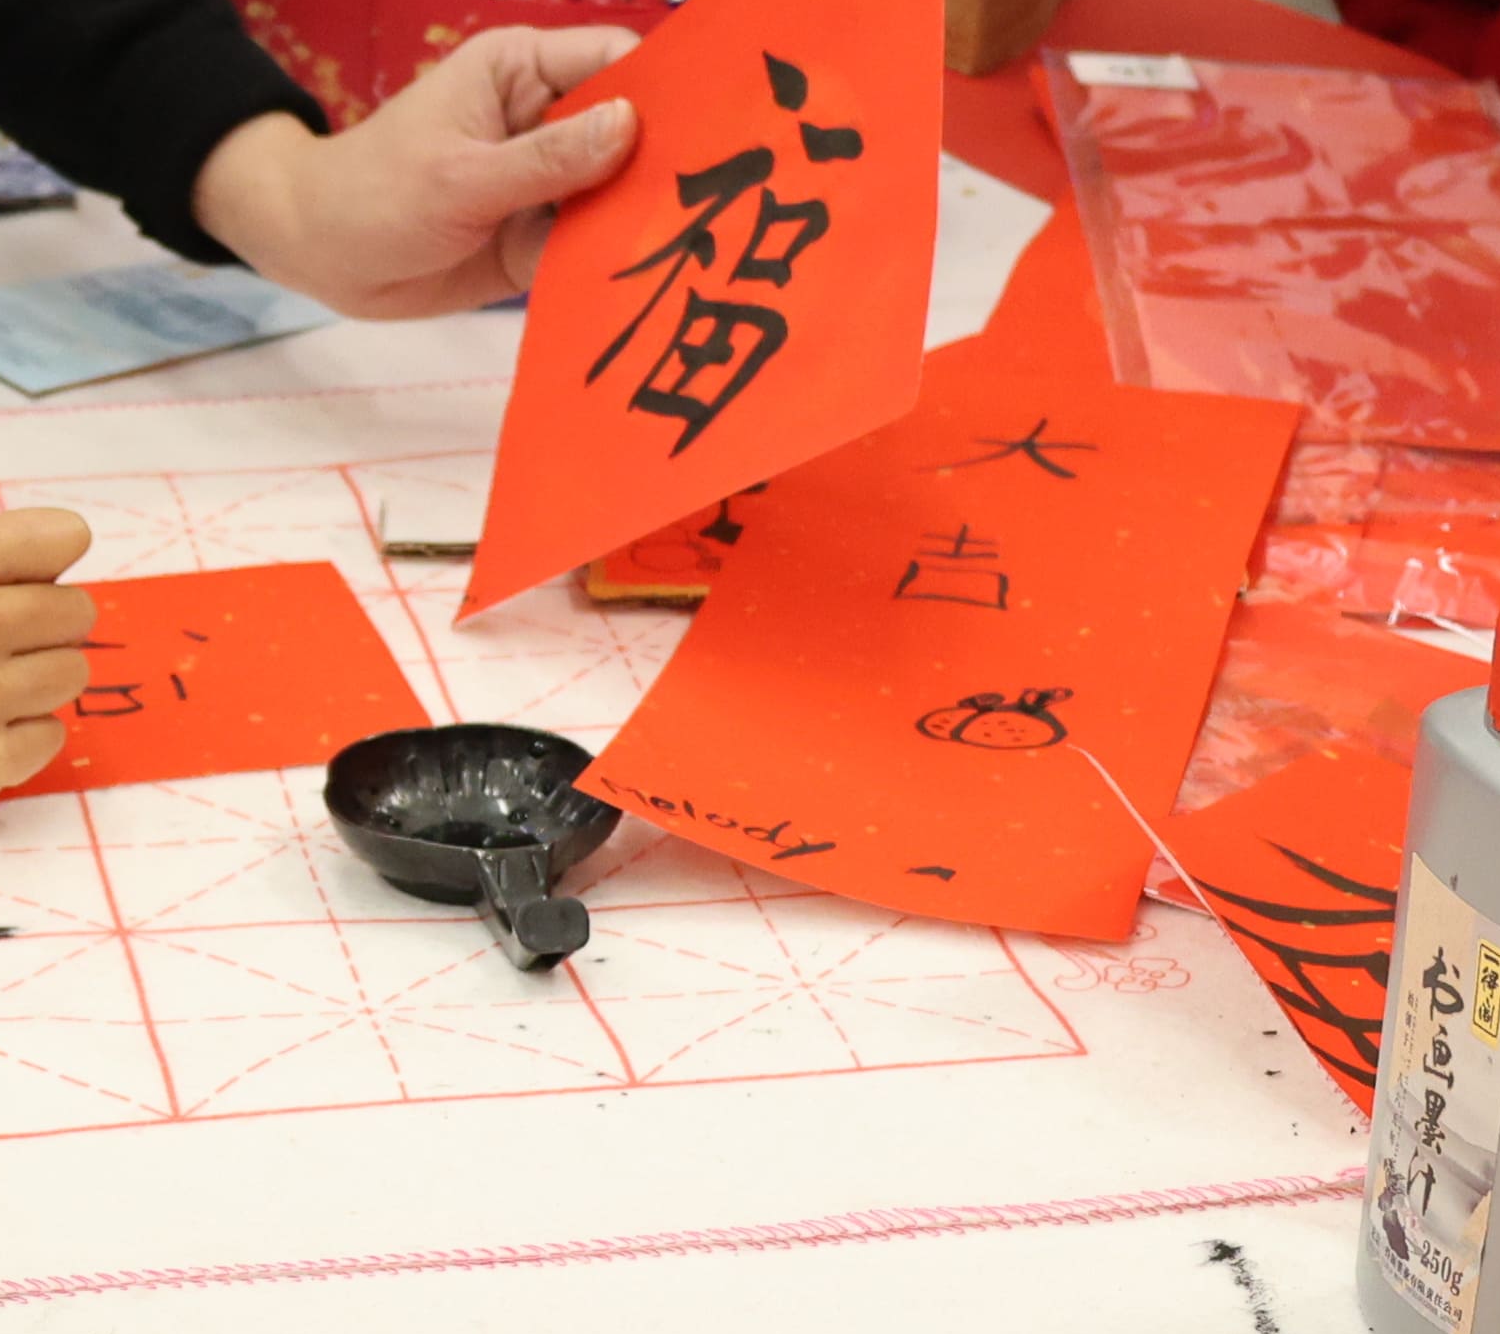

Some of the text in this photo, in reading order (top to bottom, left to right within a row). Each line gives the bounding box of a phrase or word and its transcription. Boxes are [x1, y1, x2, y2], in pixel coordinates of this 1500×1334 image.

[584, 49, 865, 460] 福
[893, 417, 1100, 612] 大吉
[1406, 945, 1466, 1218] 书画墨汁
[1420, 1239, 1464, 1298] 250g
